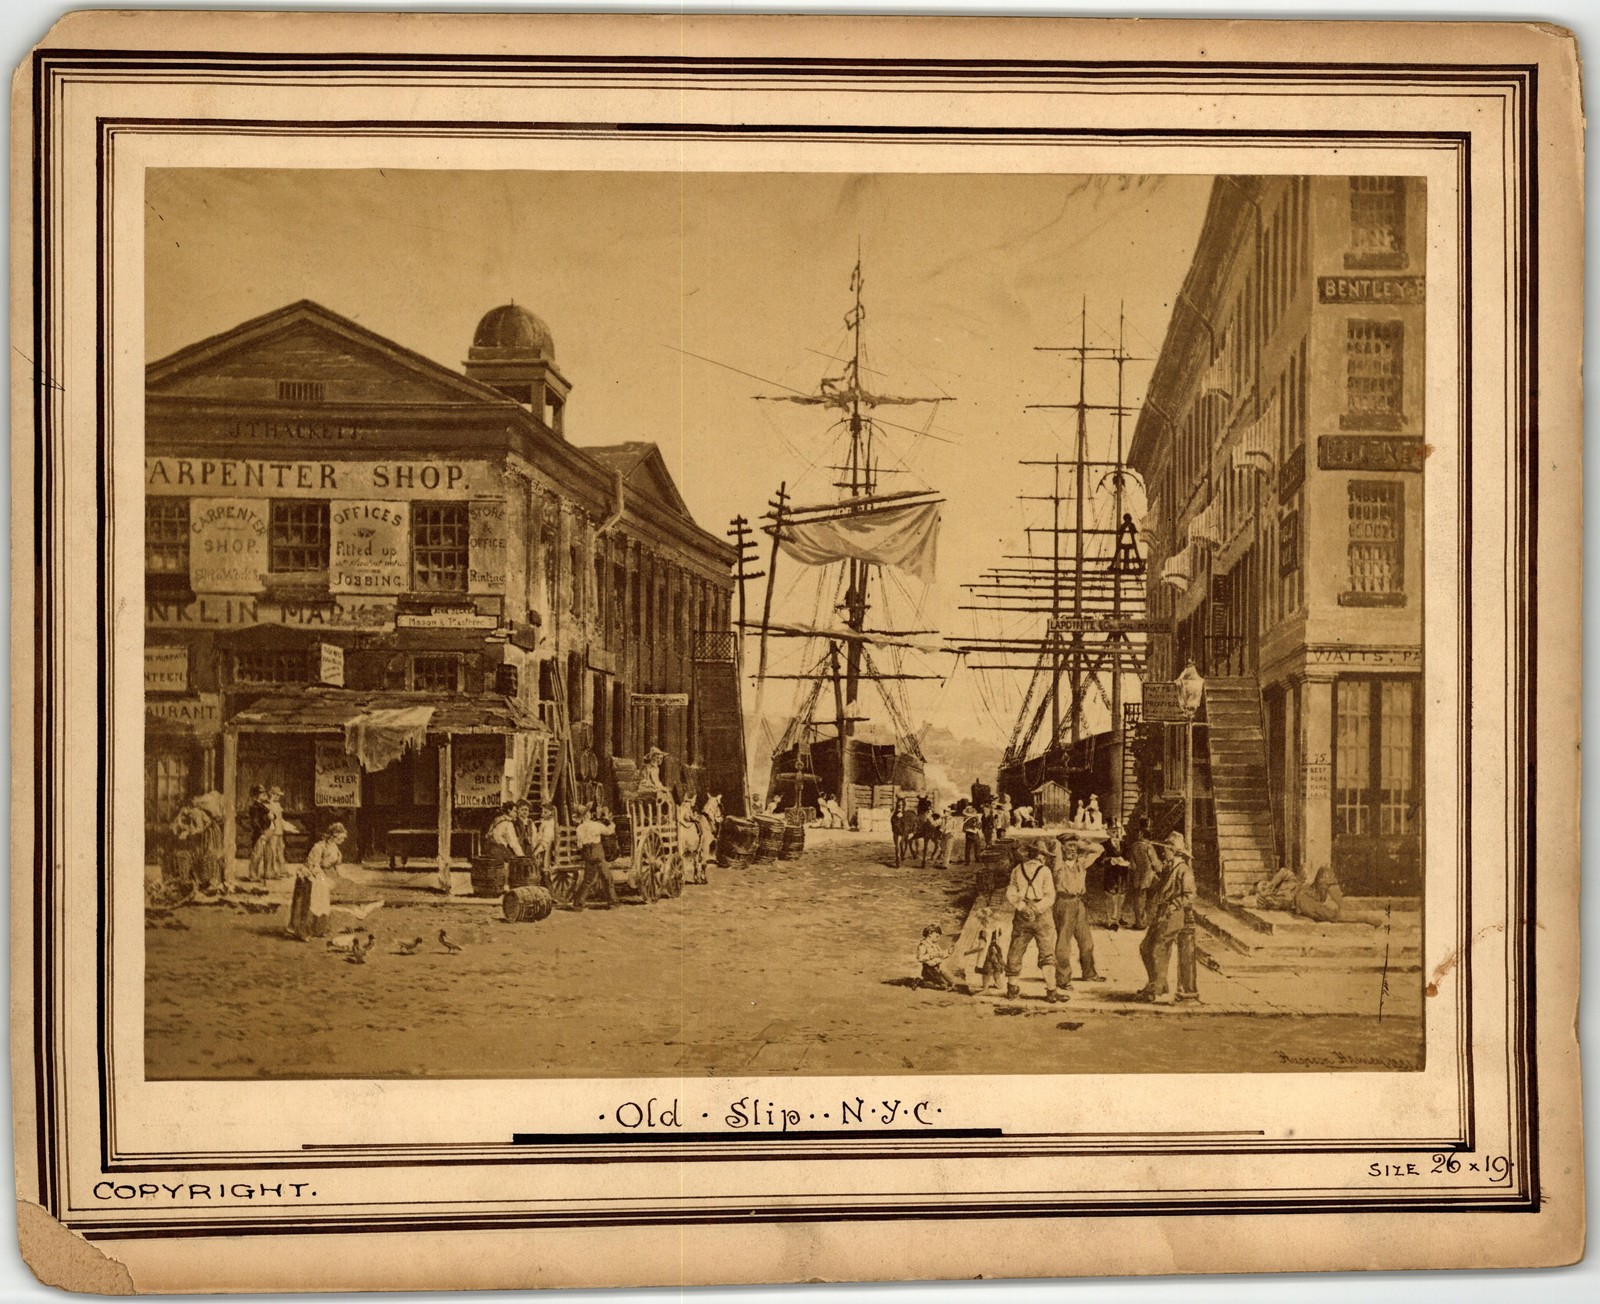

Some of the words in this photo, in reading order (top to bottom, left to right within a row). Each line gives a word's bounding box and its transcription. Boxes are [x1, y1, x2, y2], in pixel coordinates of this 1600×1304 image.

[145, 459, 338, 490] ARPENTER
[372, 464, 471, 490] SHOP.
[191, 505, 267, 535] CARPENTER
[333, 504, 403, 527] OFFICES
[468, 505, 506, 521] STORE
[203, 538, 260, 555] SHOP.
[336, 540, 373, 557] Fitted
[382, 546, 397, 562] up
[469, 537, 505, 549] OFFICE
[333, 571, 405, 587] JOBBING.
[334, 775, 357, 784] BIER
[474, 775, 500, 784] BIER
[725, 1096, 801, 1132] Slip
[1368, 1163, 1420, 1177] SIZE
[93, 1181, 318, 1200] COPYRIGHT.
